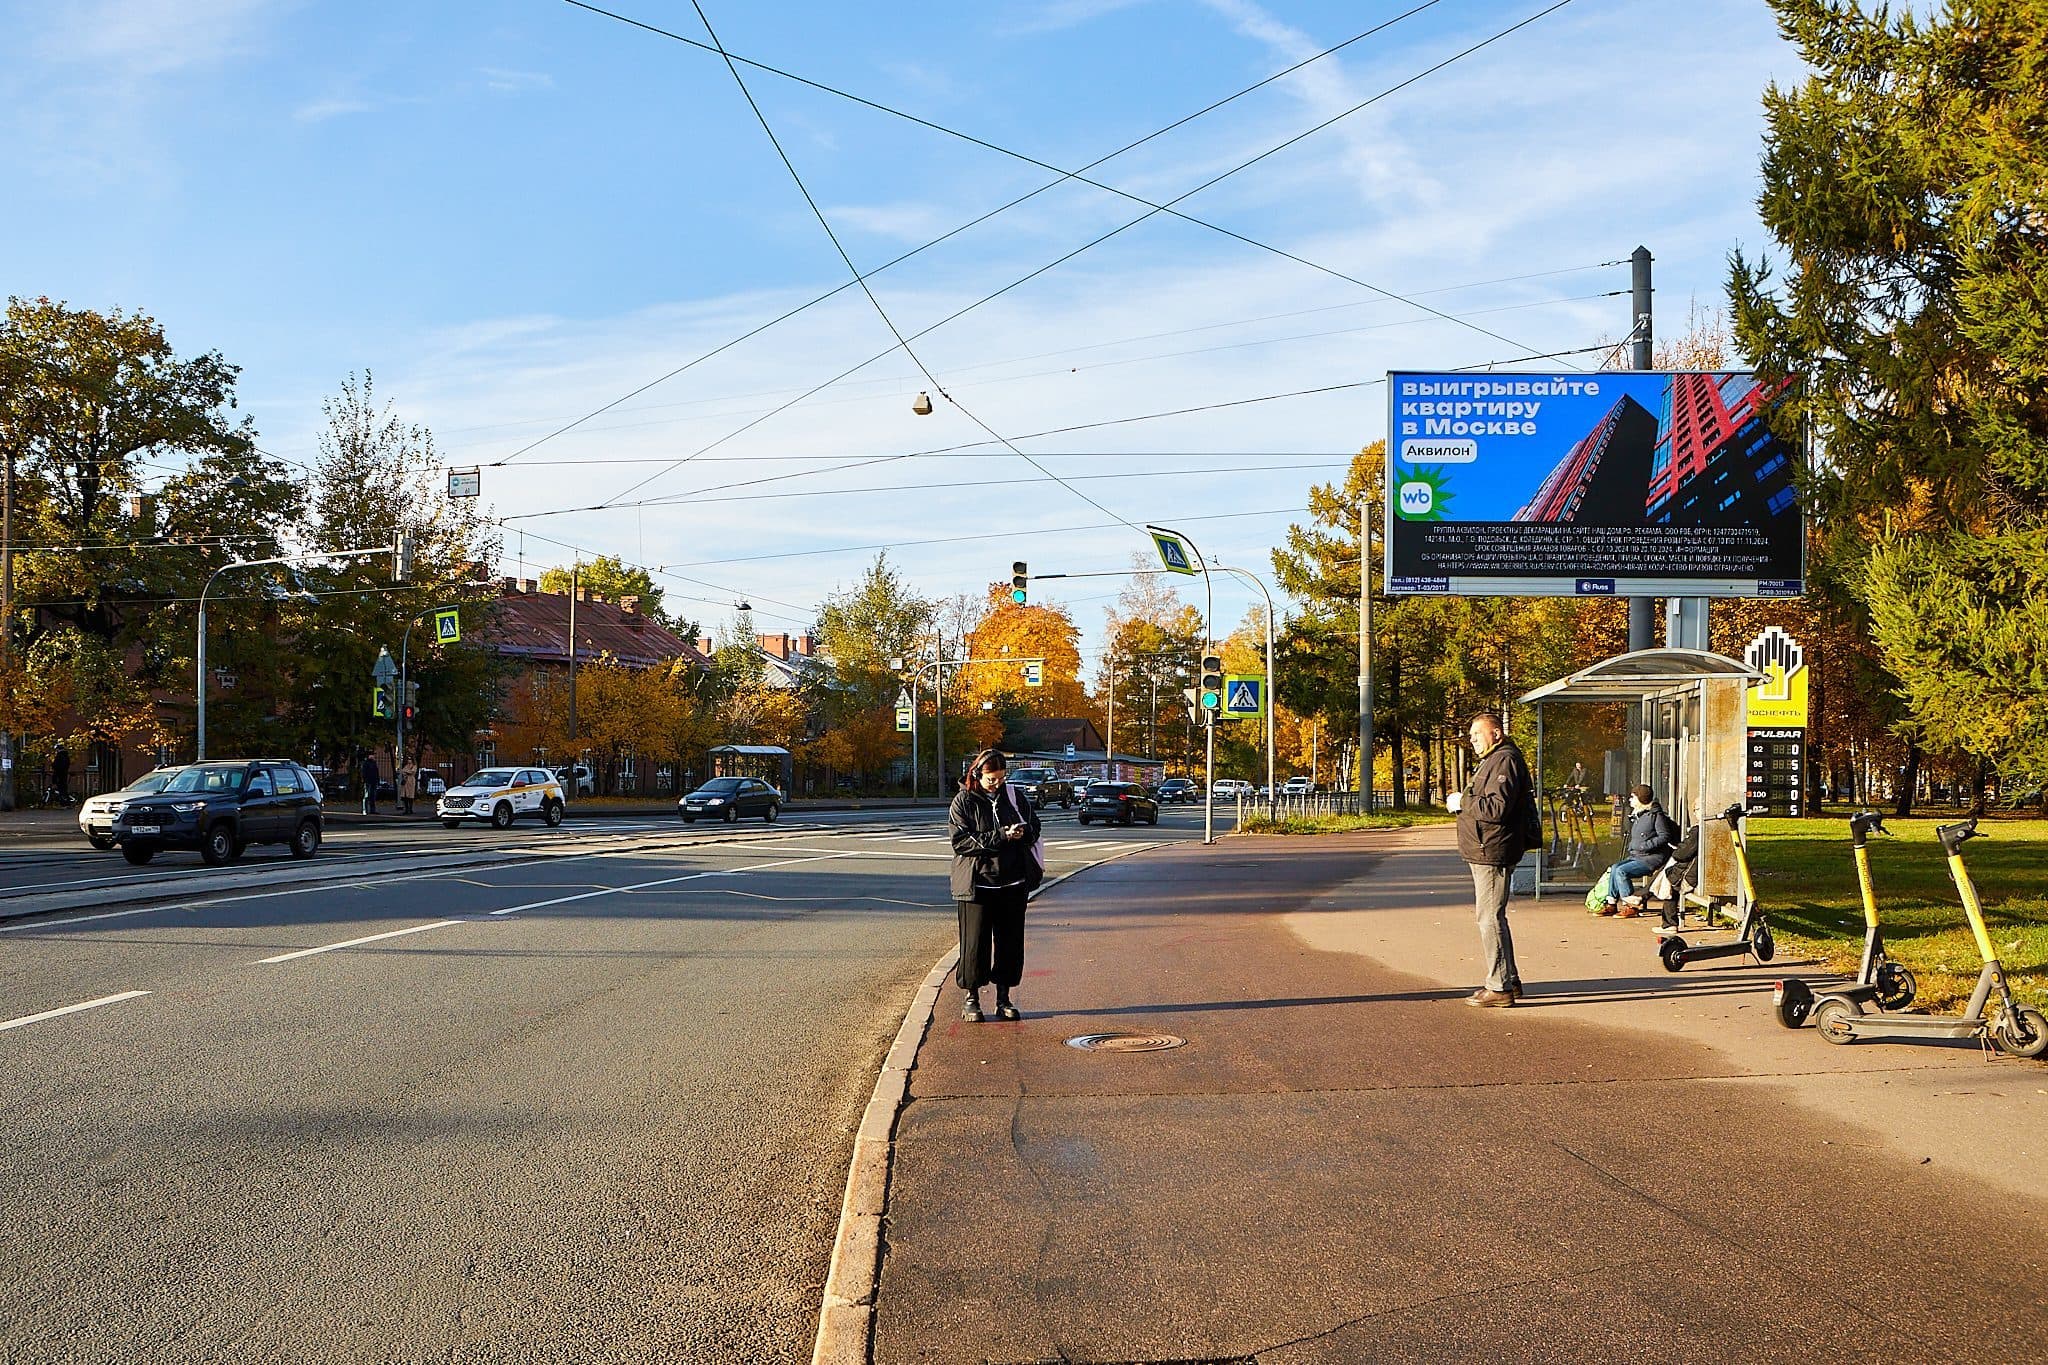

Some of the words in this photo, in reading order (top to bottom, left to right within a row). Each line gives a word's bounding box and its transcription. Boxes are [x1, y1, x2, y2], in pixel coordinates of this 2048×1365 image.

[1402, 377, 1600, 399] выигрывайте
[1402, 402, 1541, 418] квартиру
[1402, 421, 1418, 435] в
[1426, 418, 1536, 435] Москве
[1406, 445, 1470, 456] Аквилон
[1402, 488, 1430, 504] wb
